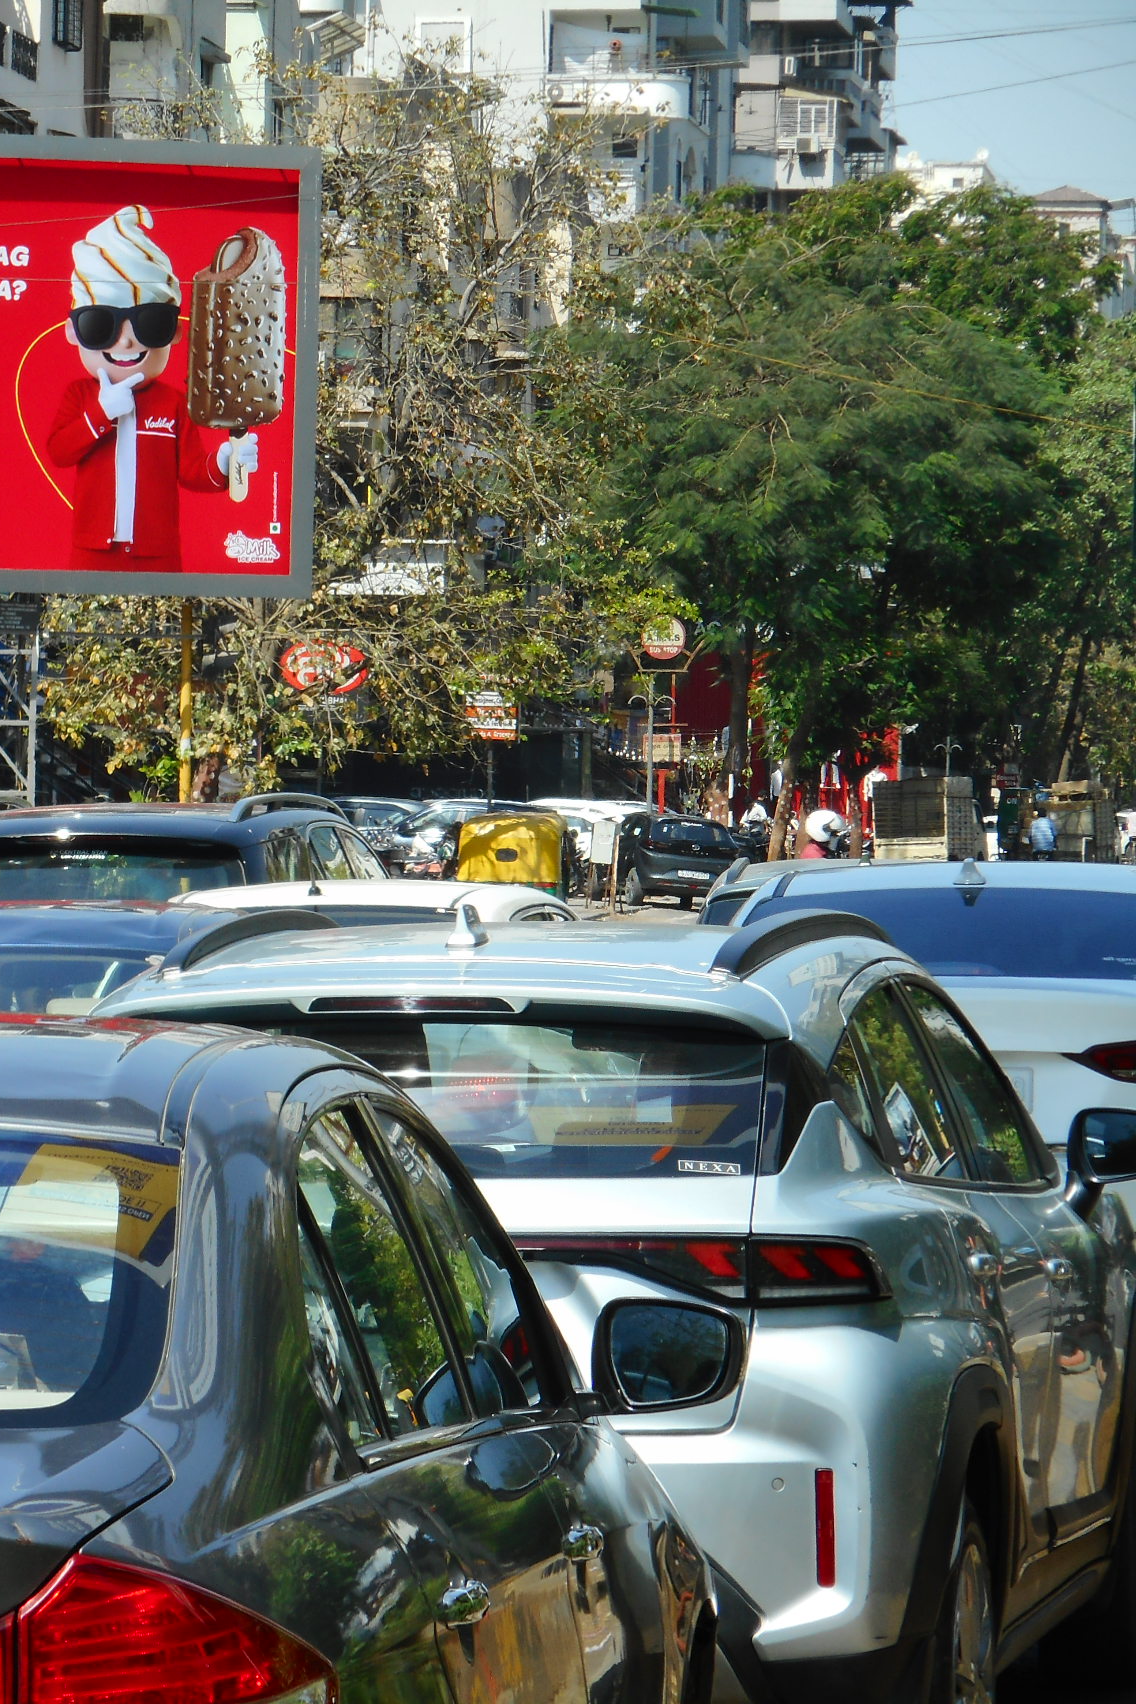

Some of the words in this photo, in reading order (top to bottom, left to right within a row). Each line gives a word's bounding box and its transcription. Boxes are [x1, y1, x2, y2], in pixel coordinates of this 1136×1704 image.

[144, 416, 175, 432] Vadilal
[246, 539, 279, 558] Milk
[684, 1162, 736, 1173] NEXA
